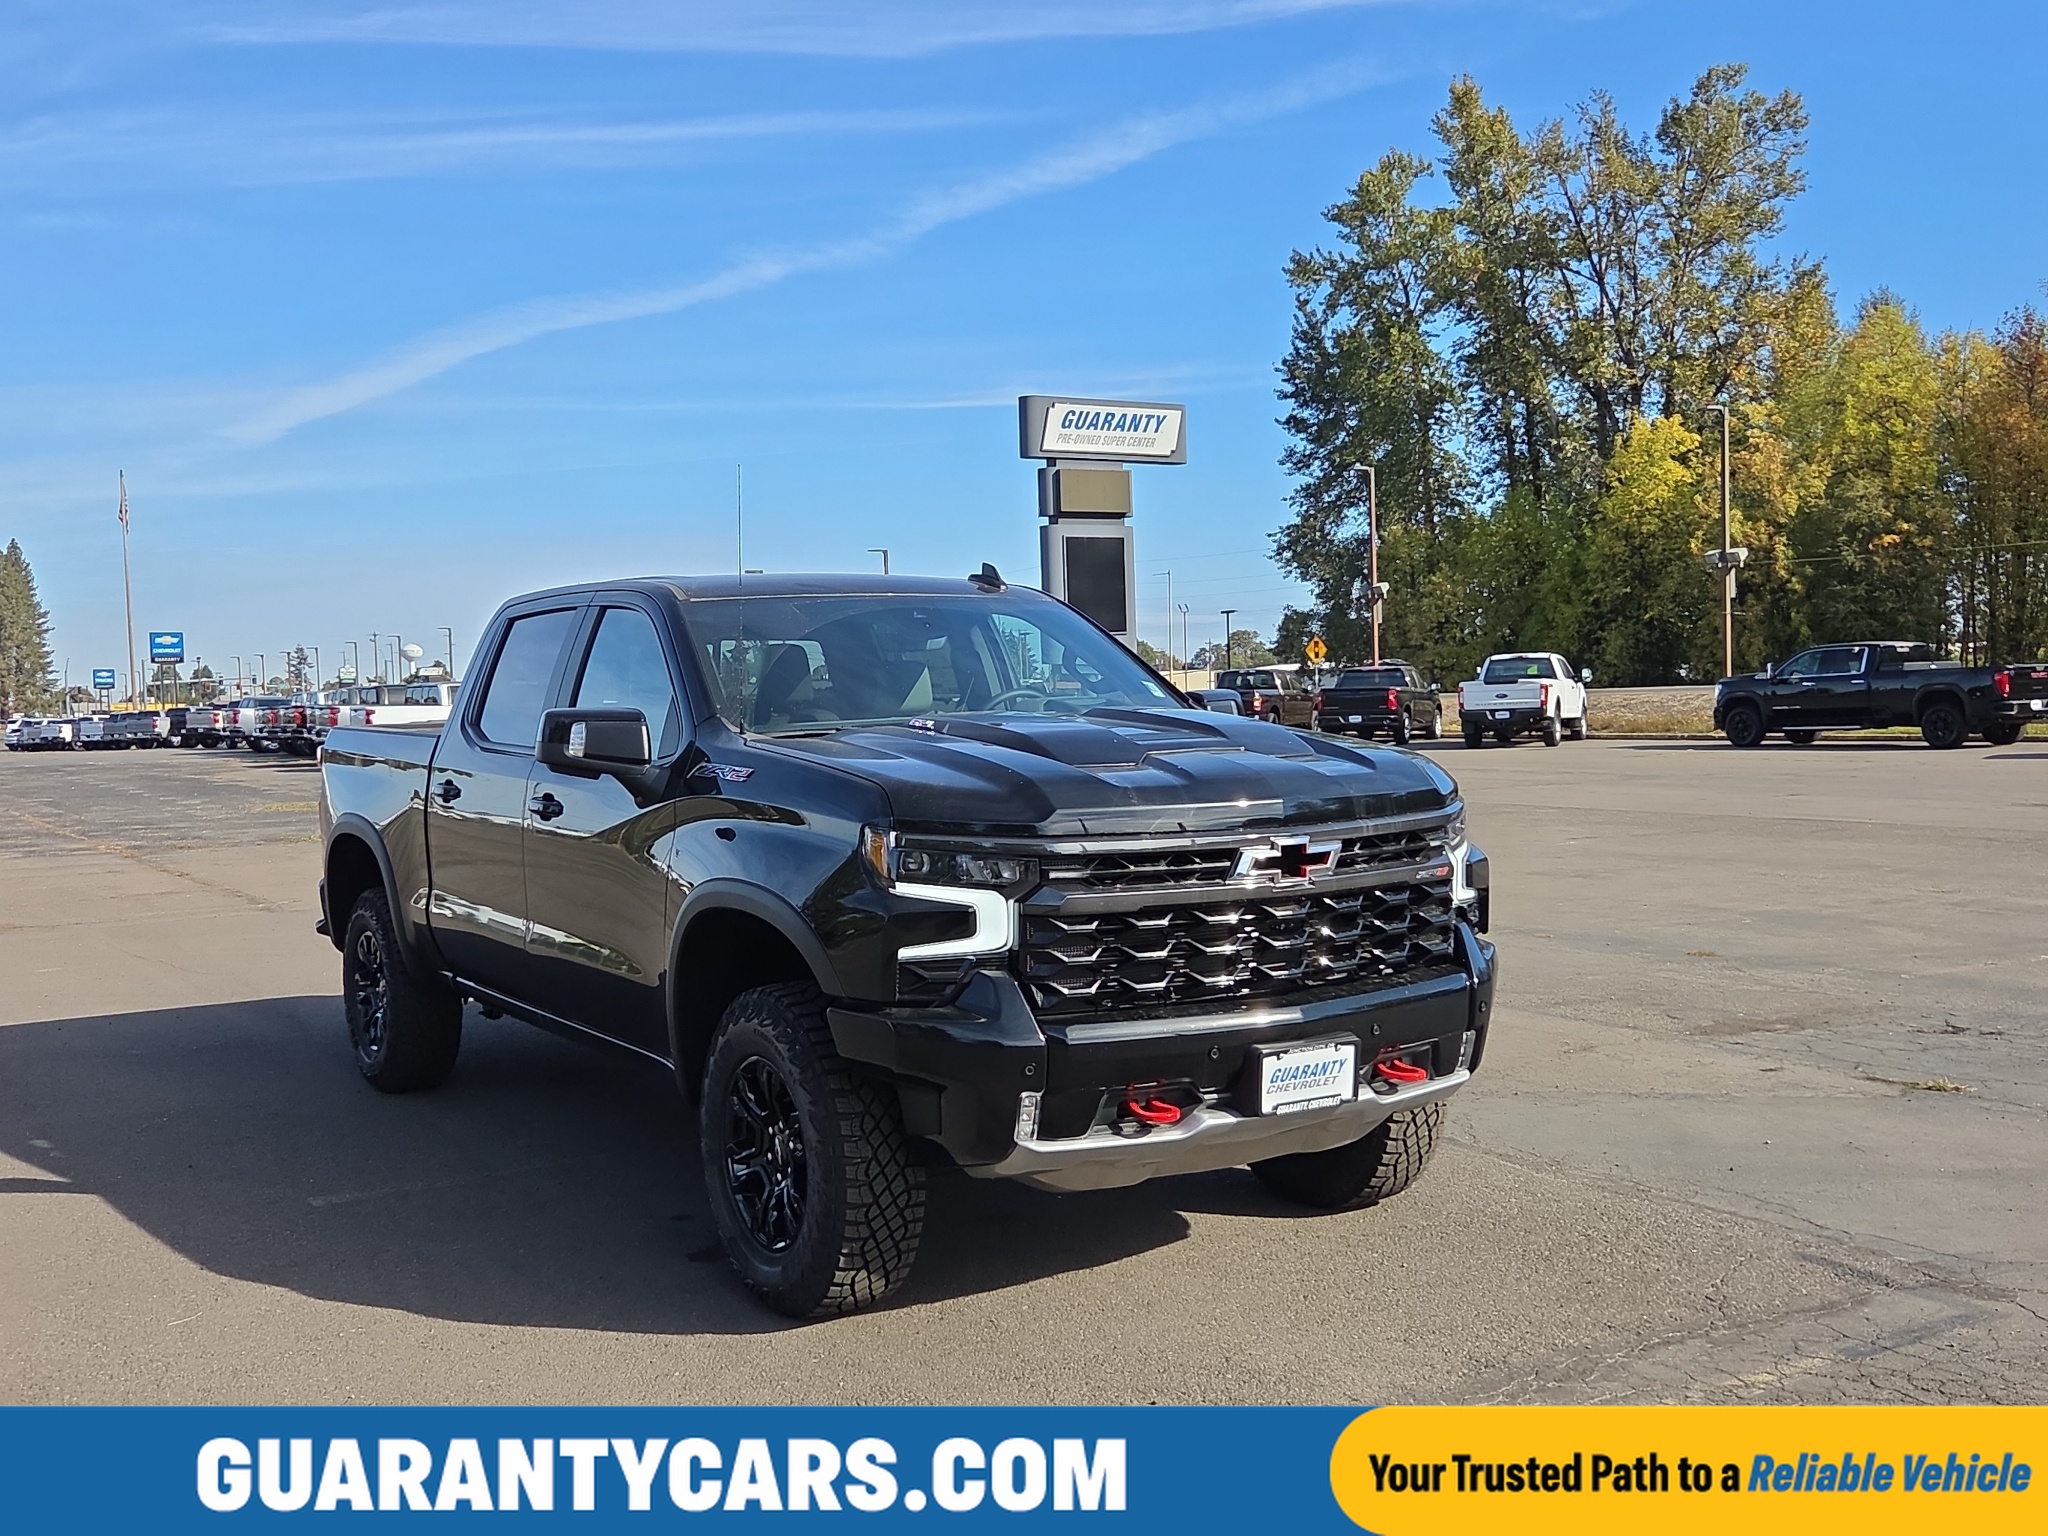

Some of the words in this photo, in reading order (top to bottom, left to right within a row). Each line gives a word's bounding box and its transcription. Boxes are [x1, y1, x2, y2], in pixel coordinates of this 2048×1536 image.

[1061, 410, 1167, 433] GUARANTY
[1056, 433, 1100, 446] PRE-OWNED
[1101, 435, 1126, 447] SUPER
[1127, 436, 1156, 448] CENTER
[1269, 1058, 1348, 1084] GUARANTY
[1266, 1075, 1339, 1095] CHEVROLET
